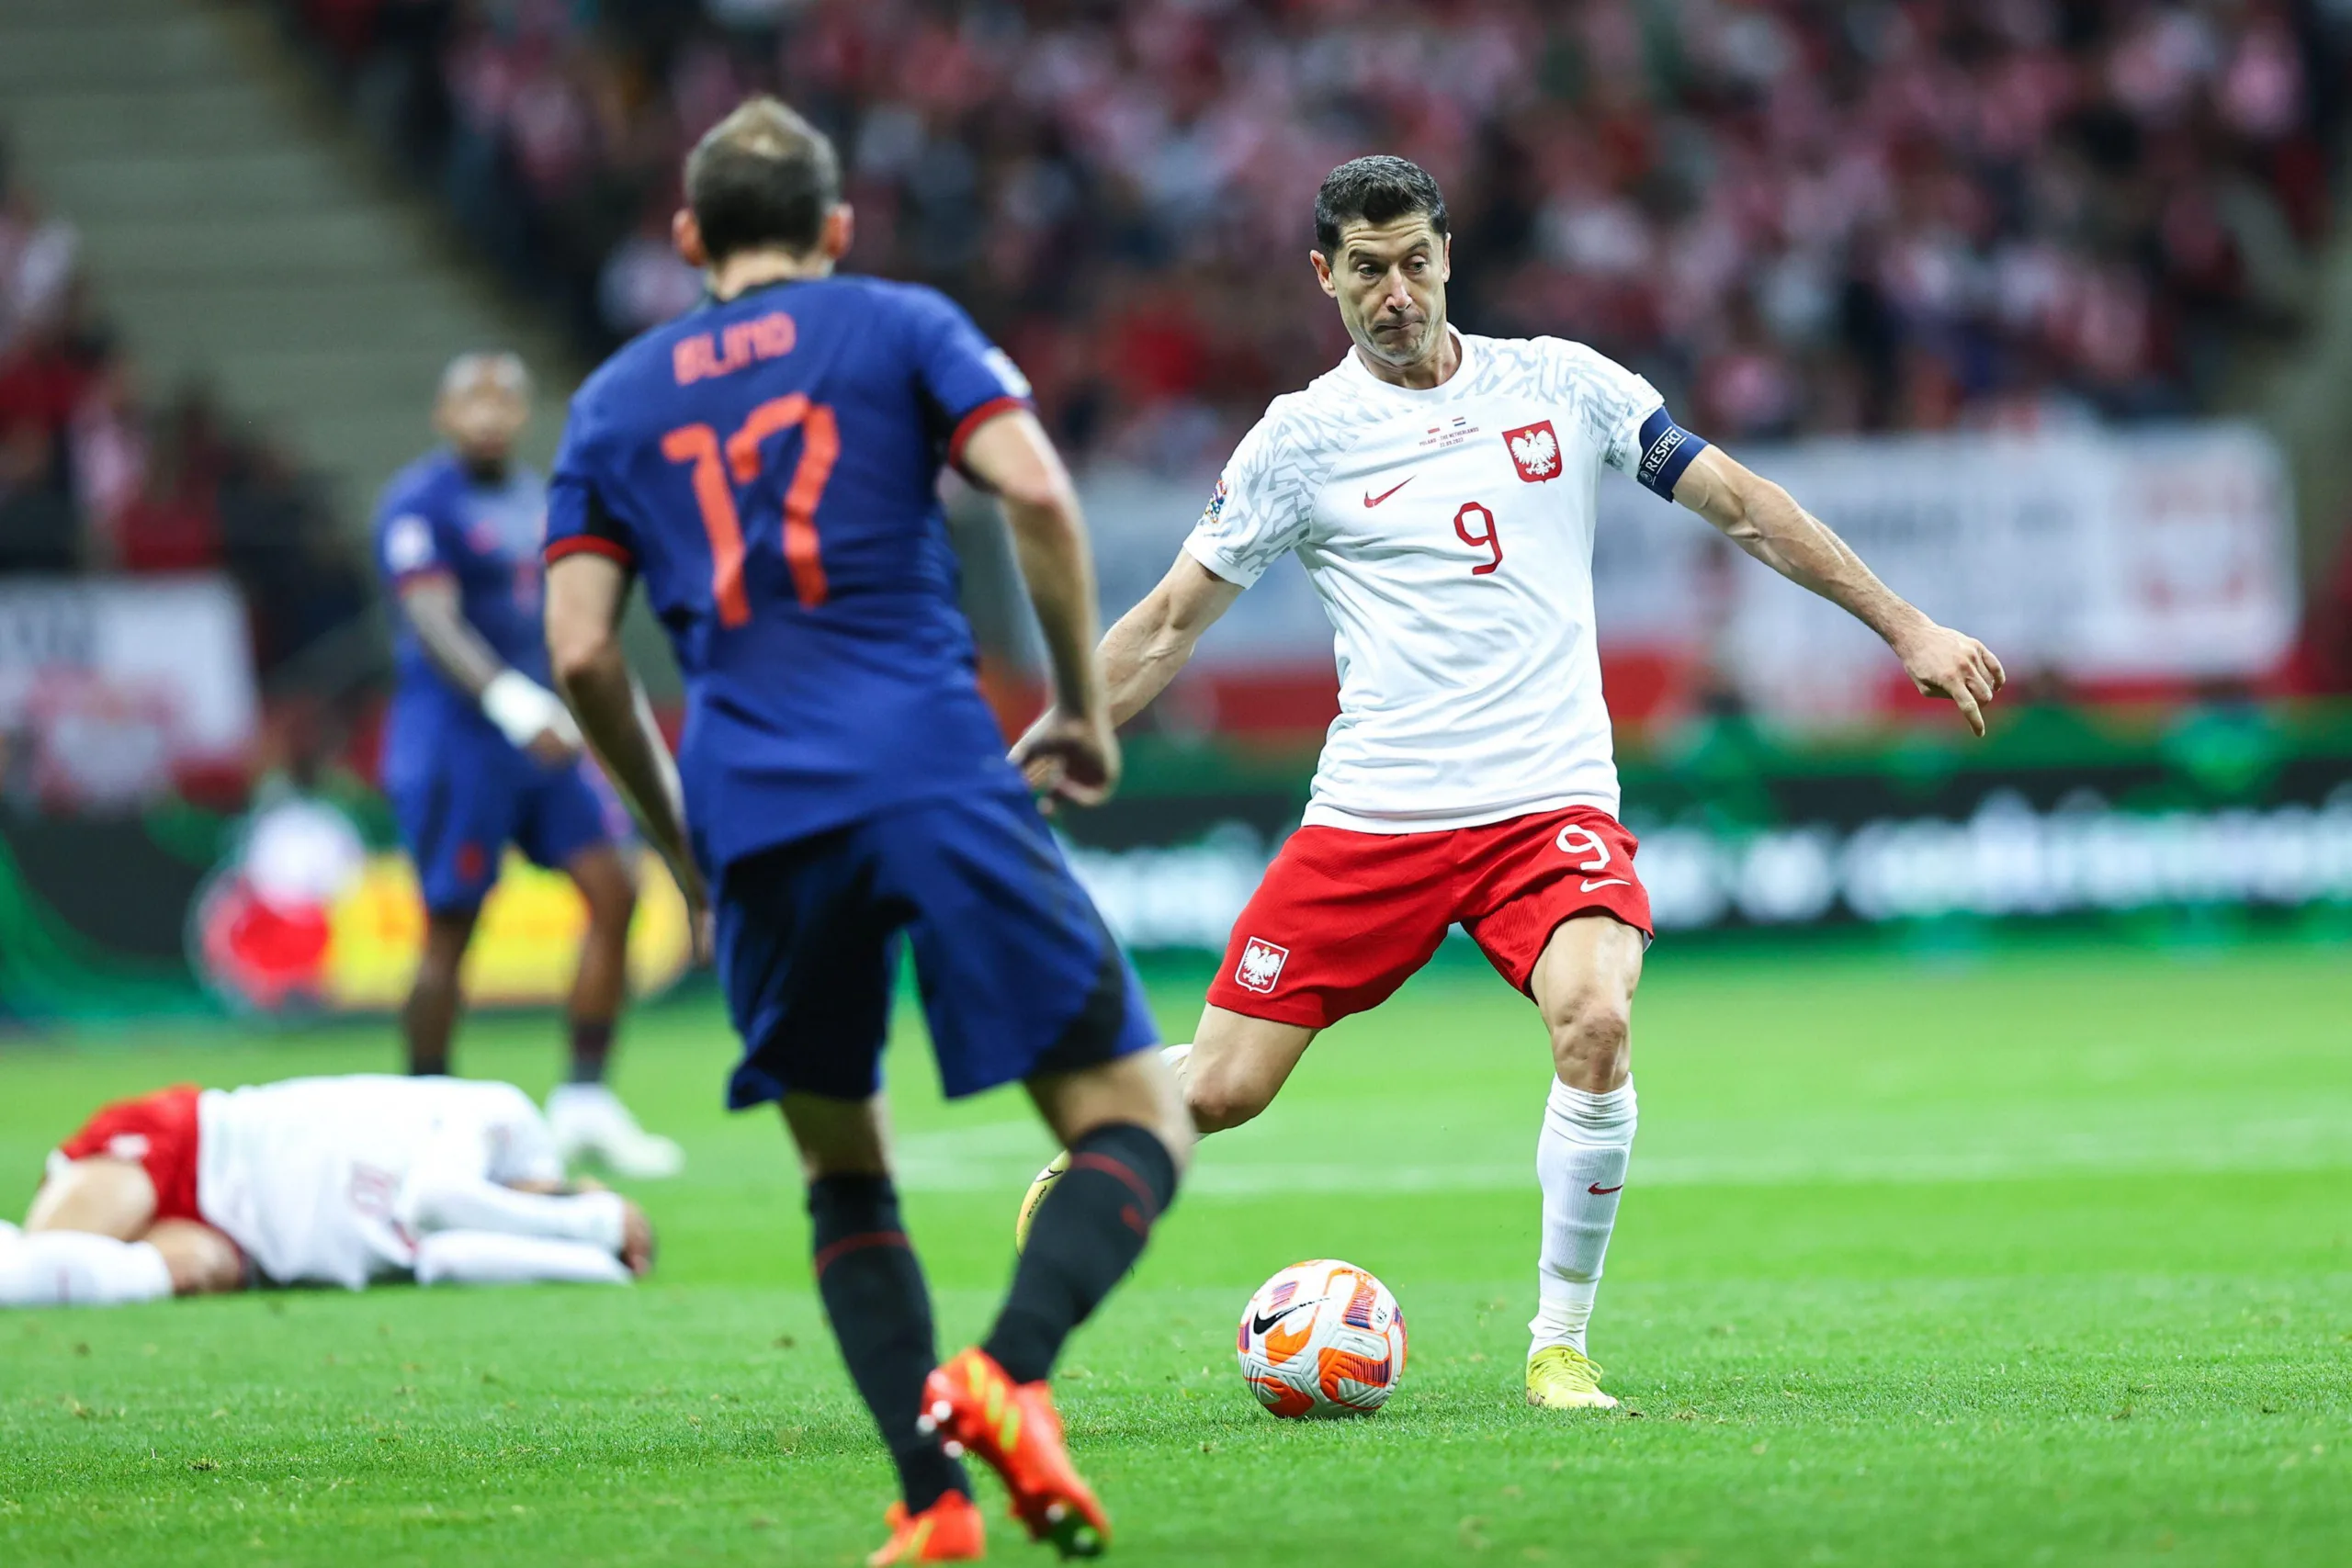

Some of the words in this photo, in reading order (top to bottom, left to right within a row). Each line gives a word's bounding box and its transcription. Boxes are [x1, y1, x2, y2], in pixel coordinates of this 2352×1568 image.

[1645, 429, 1683, 471] RESPECT
[662, 392, 840, 628] 17
[1453, 502, 1503, 575] 9
[1555, 824, 1611, 871] 9
